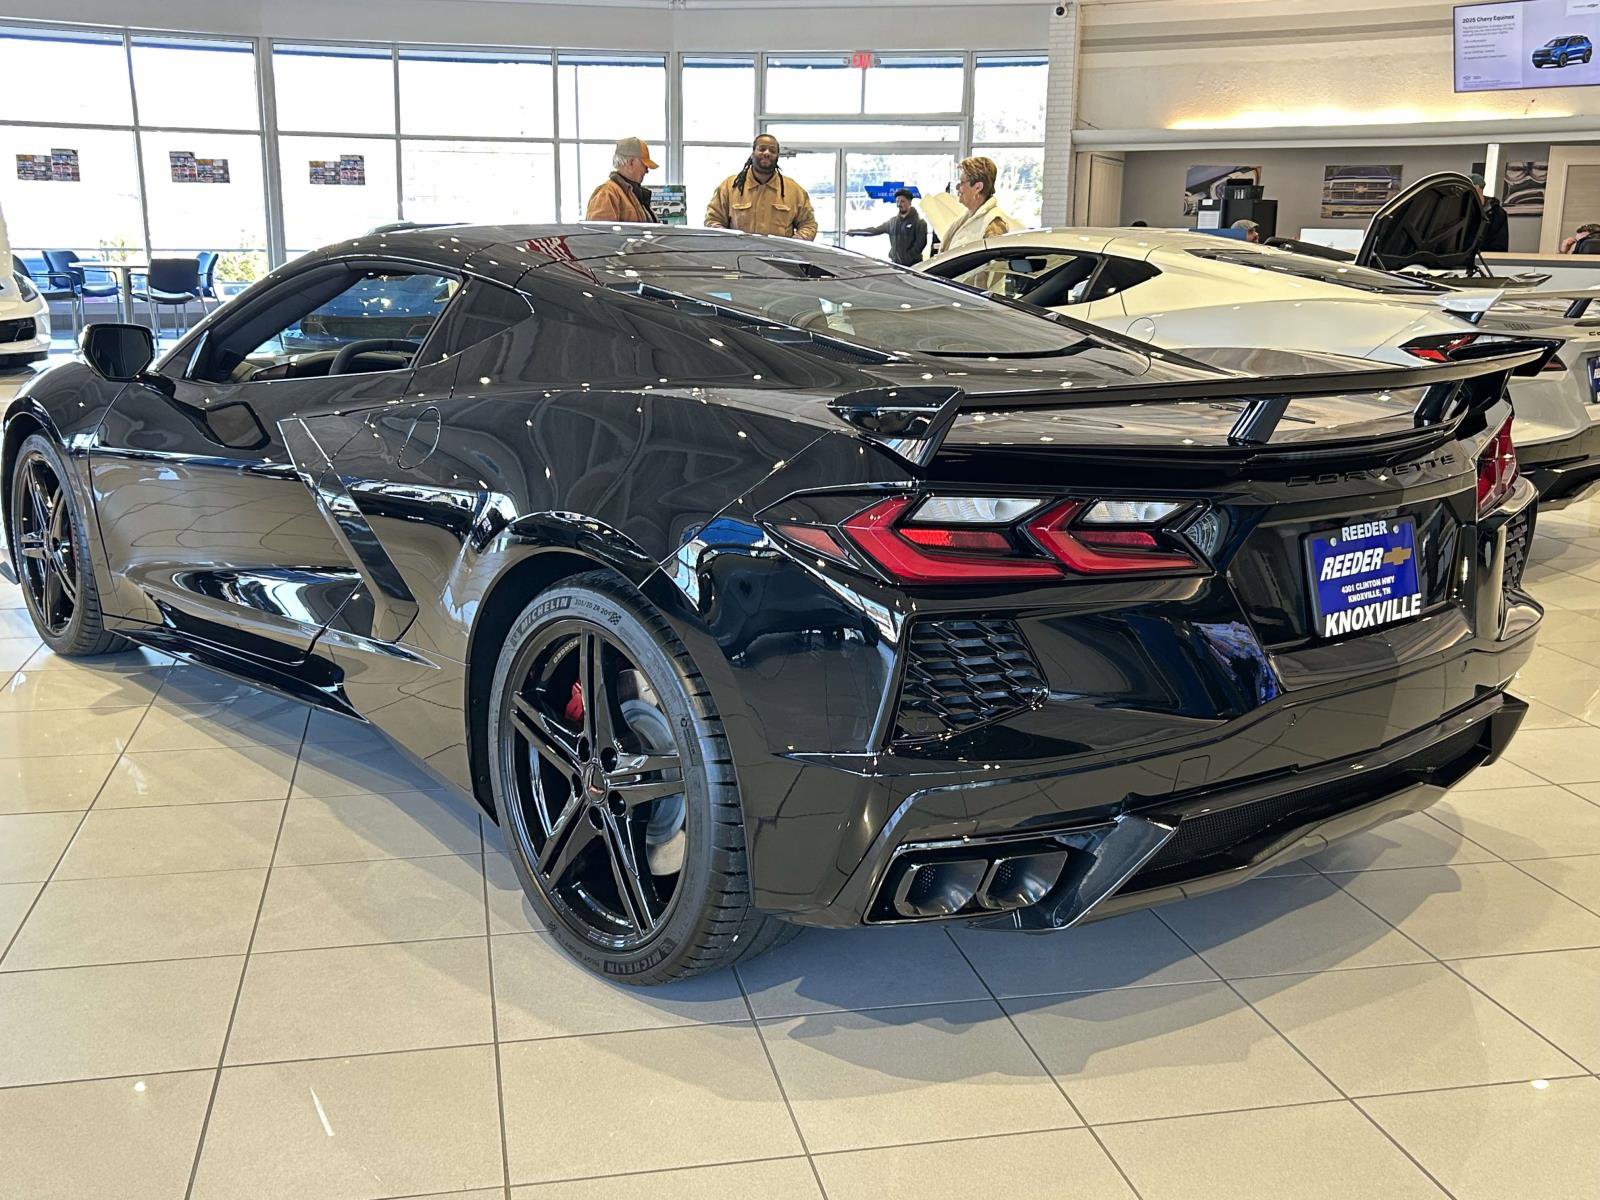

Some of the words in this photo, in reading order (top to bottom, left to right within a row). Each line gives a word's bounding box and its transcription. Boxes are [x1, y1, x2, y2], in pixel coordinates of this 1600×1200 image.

[1286, 454, 1456, 488] CORVETTE
[1341, 520, 1388, 542] REEDER
[1320, 547, 1385, 582] REEDER
[1355, 578, 1381, 591] CLINTON
[1382, 574, 1395, 584] HWY
[1382, 586, 1391, 596] TN
[521, 596, 569, 630] MICHELIN
[1325, 593, 1422, 638] KNOXVILLE
[606, 948, 662, 974] MICHELIN
